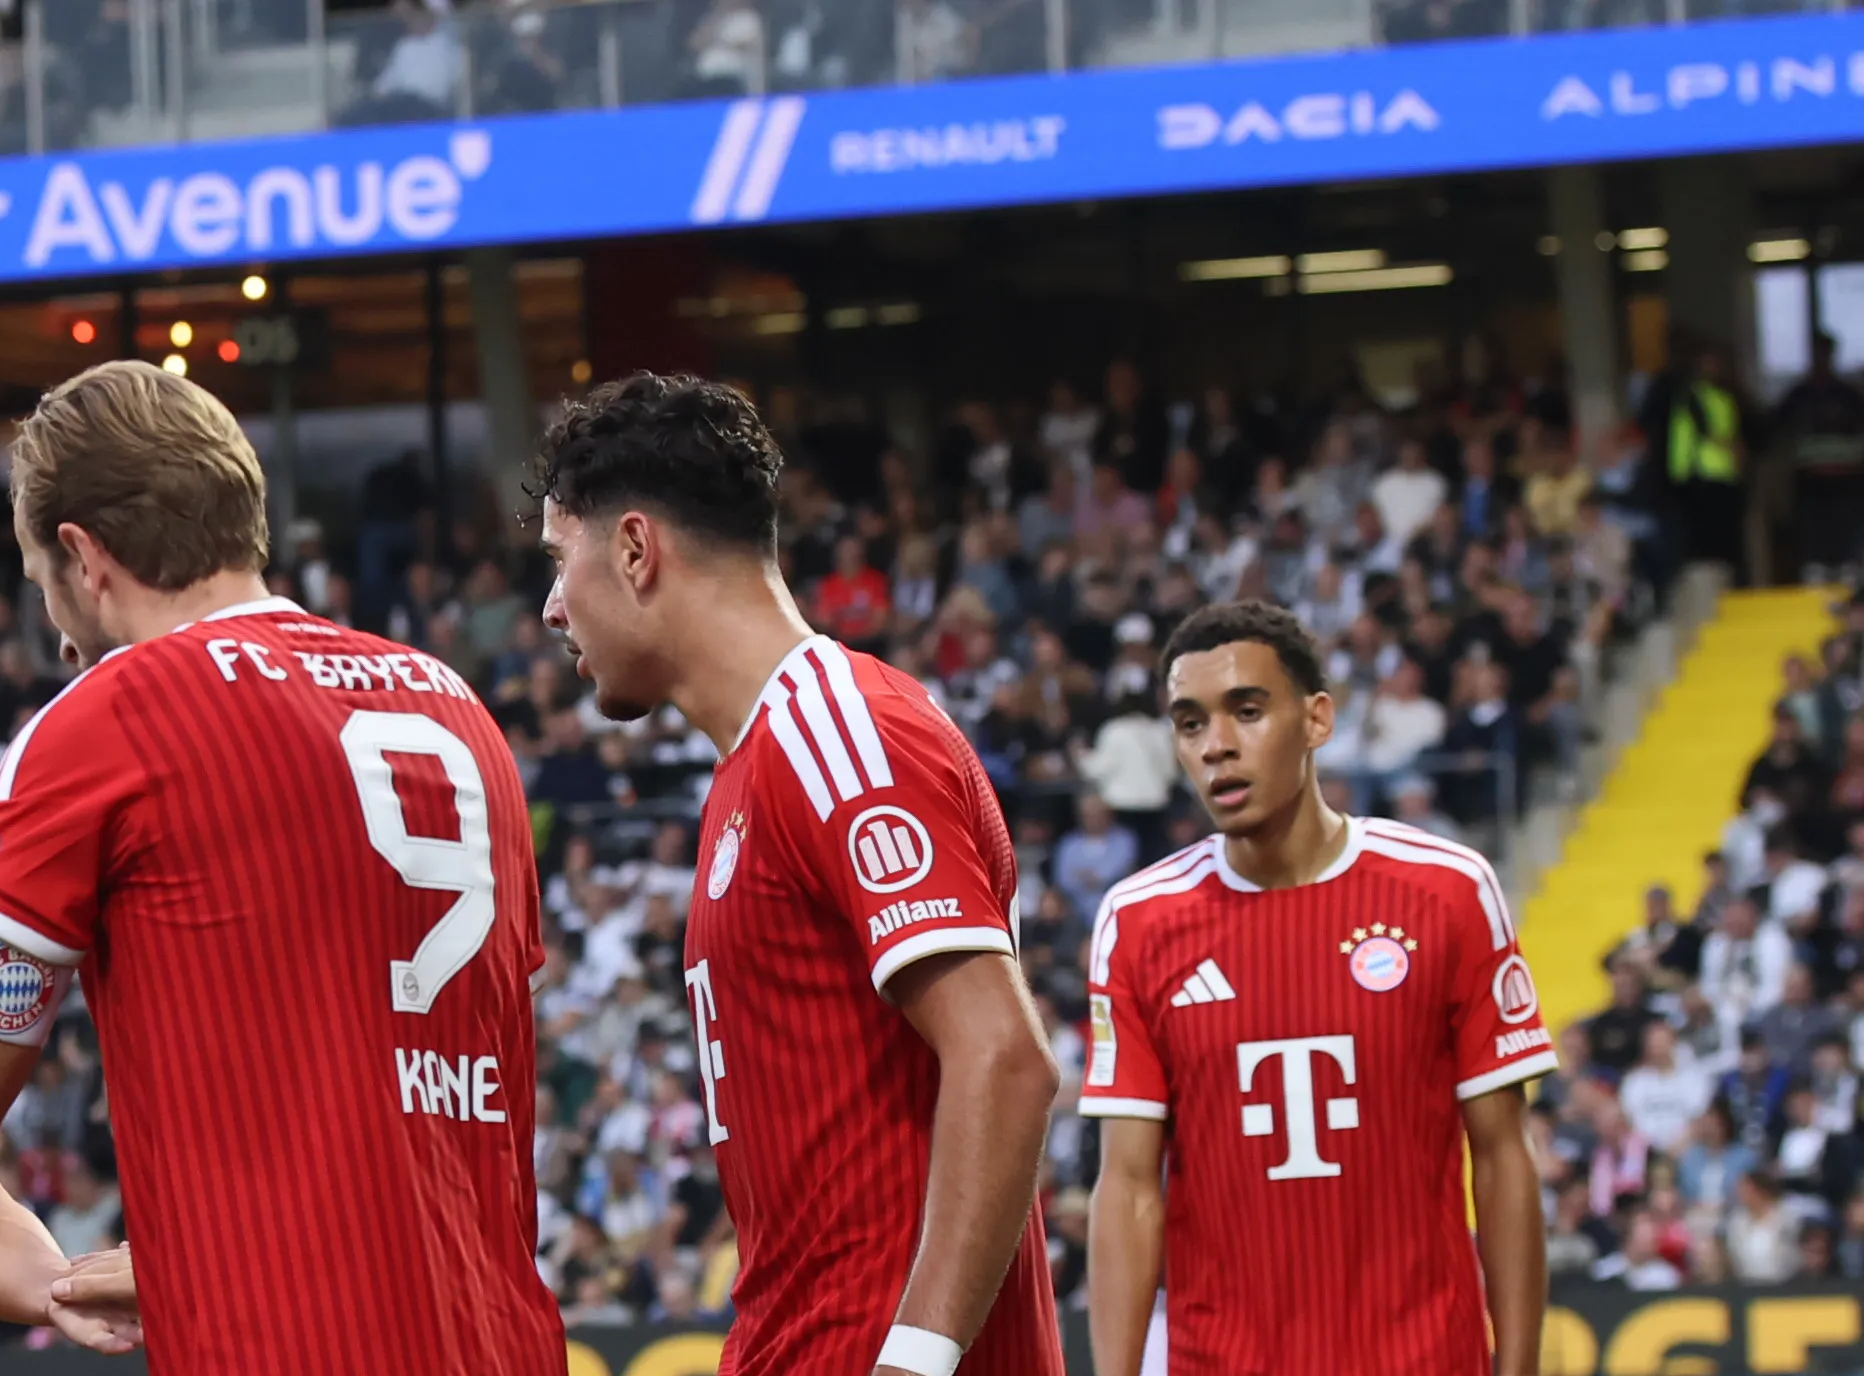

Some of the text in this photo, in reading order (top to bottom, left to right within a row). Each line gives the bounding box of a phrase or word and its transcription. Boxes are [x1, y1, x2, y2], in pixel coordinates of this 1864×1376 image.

[831, 116, 1065, 174] RENAULT
[1158, 90, 1439, 150] DACIA
[206, 638, 480, 706] FC BAYERN
[338, 709, 496, 1014] 9
[867, 897, 963, 947] Allianz
[395, 1047, 506, 1123] KANE
[685, 959, 729, 1146] T
[1237, 1034, 1358, 1181] T
